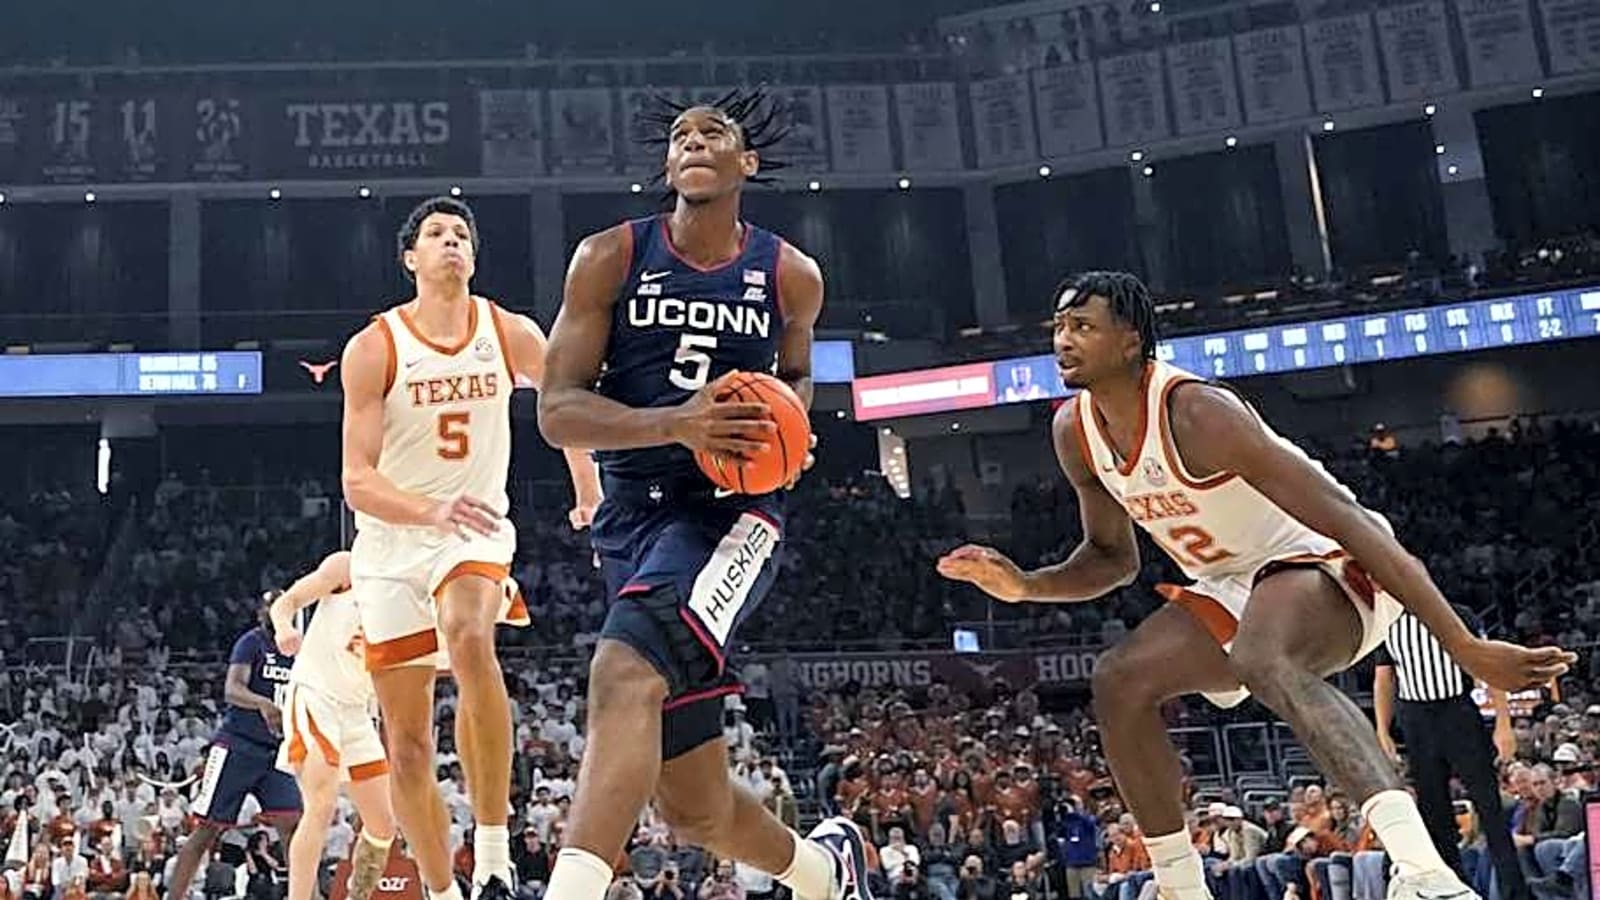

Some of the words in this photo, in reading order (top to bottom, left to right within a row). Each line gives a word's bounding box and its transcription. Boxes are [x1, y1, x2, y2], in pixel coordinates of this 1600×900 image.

[56, 101, 90, 144] 15
[286, 102, 450, 146] TEXAS
[308, 153, 430, 169] BASKETBALL
[629, 298, 770, 338] UCONN
[1537, 298, 1553, 315] FT
[669, 333, 717, 391] 5
[1214, 358, 1224, 376] 2
[1538, 318, 1562, 338] 2-2
[407, 372, 498, 407] TEXAS
[437, 411, 471, 460] 5
[705, 522, 769, 623] HUSKIES
[263, 665, 289, 682] UCO
[800, 660, 931, 687] NGHORNS
[1036, 653, 1096, 682] HOO
[378, 876, 409, 892] azr
